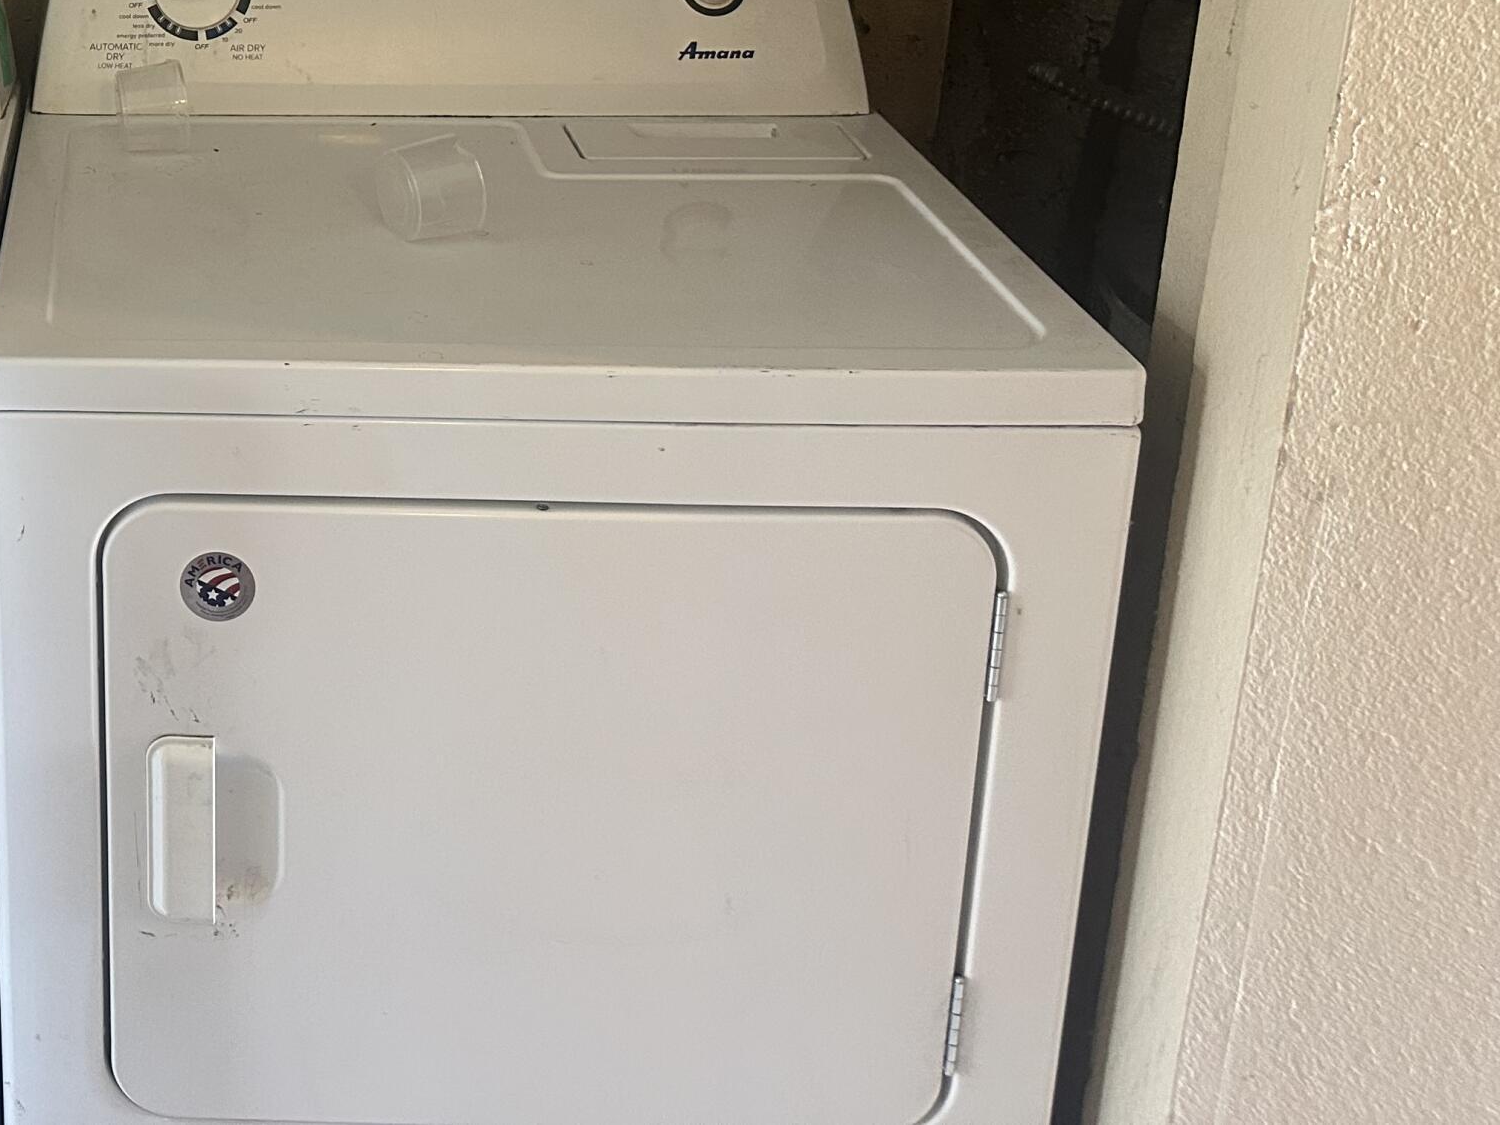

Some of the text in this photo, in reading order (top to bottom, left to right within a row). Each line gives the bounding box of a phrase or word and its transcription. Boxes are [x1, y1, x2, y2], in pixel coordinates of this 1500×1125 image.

[89, 42, 143, 51] AUTOMATIC
[230, 43, 266, 52] AIR DRY
[677, 41, 755, 61] Amana
[106, 52, 125, 61] DRY
[184, 555, 243, 588] AMERICA
